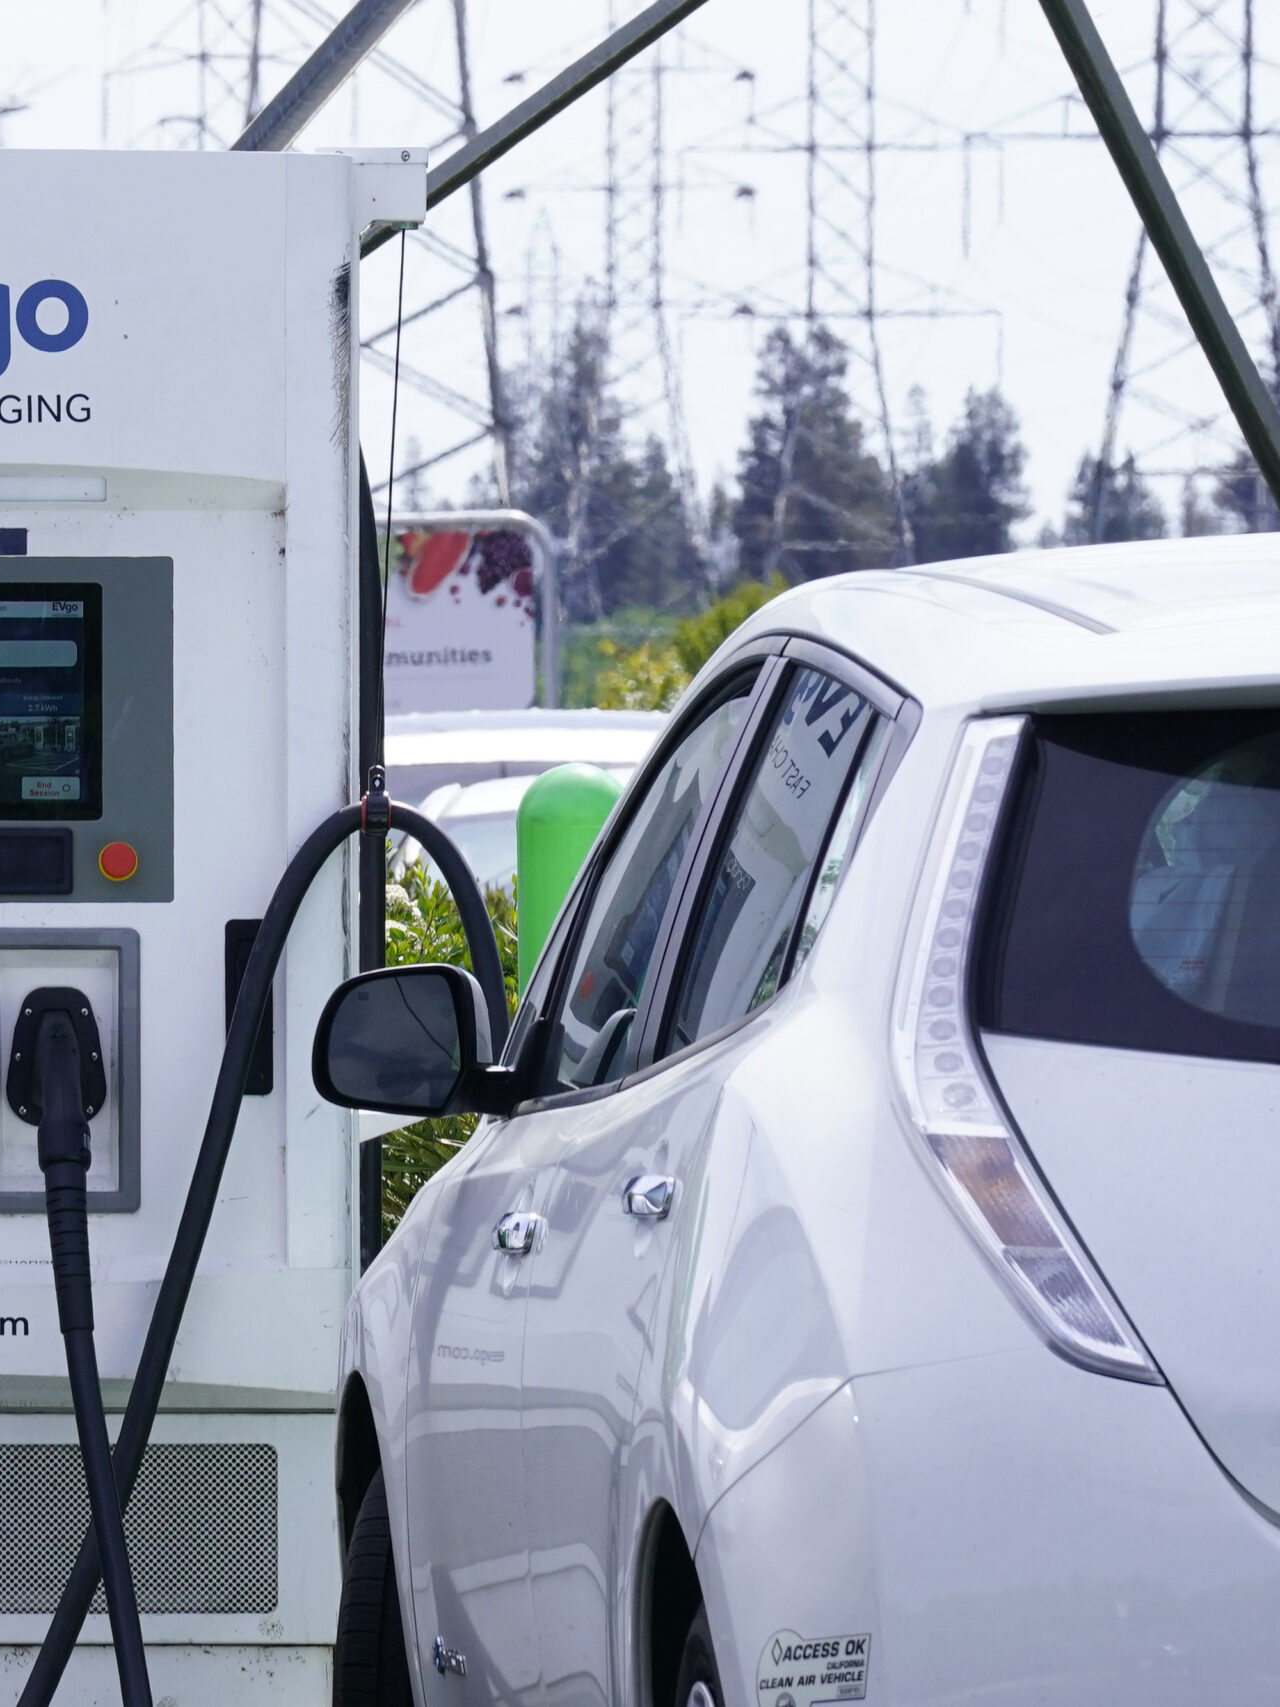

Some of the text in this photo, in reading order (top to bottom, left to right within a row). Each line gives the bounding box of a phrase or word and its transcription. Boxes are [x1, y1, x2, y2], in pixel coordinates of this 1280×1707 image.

[52, 602, 78, 614] EVgo
[36, 781, 52, 789] End
[783, 1638, 867, 1662] ACCESS OK
[826, 1659, 865, 1670] CALIFORNIA
[759, 1670, 864, 1690] CLEAN AIR VEHICLE
